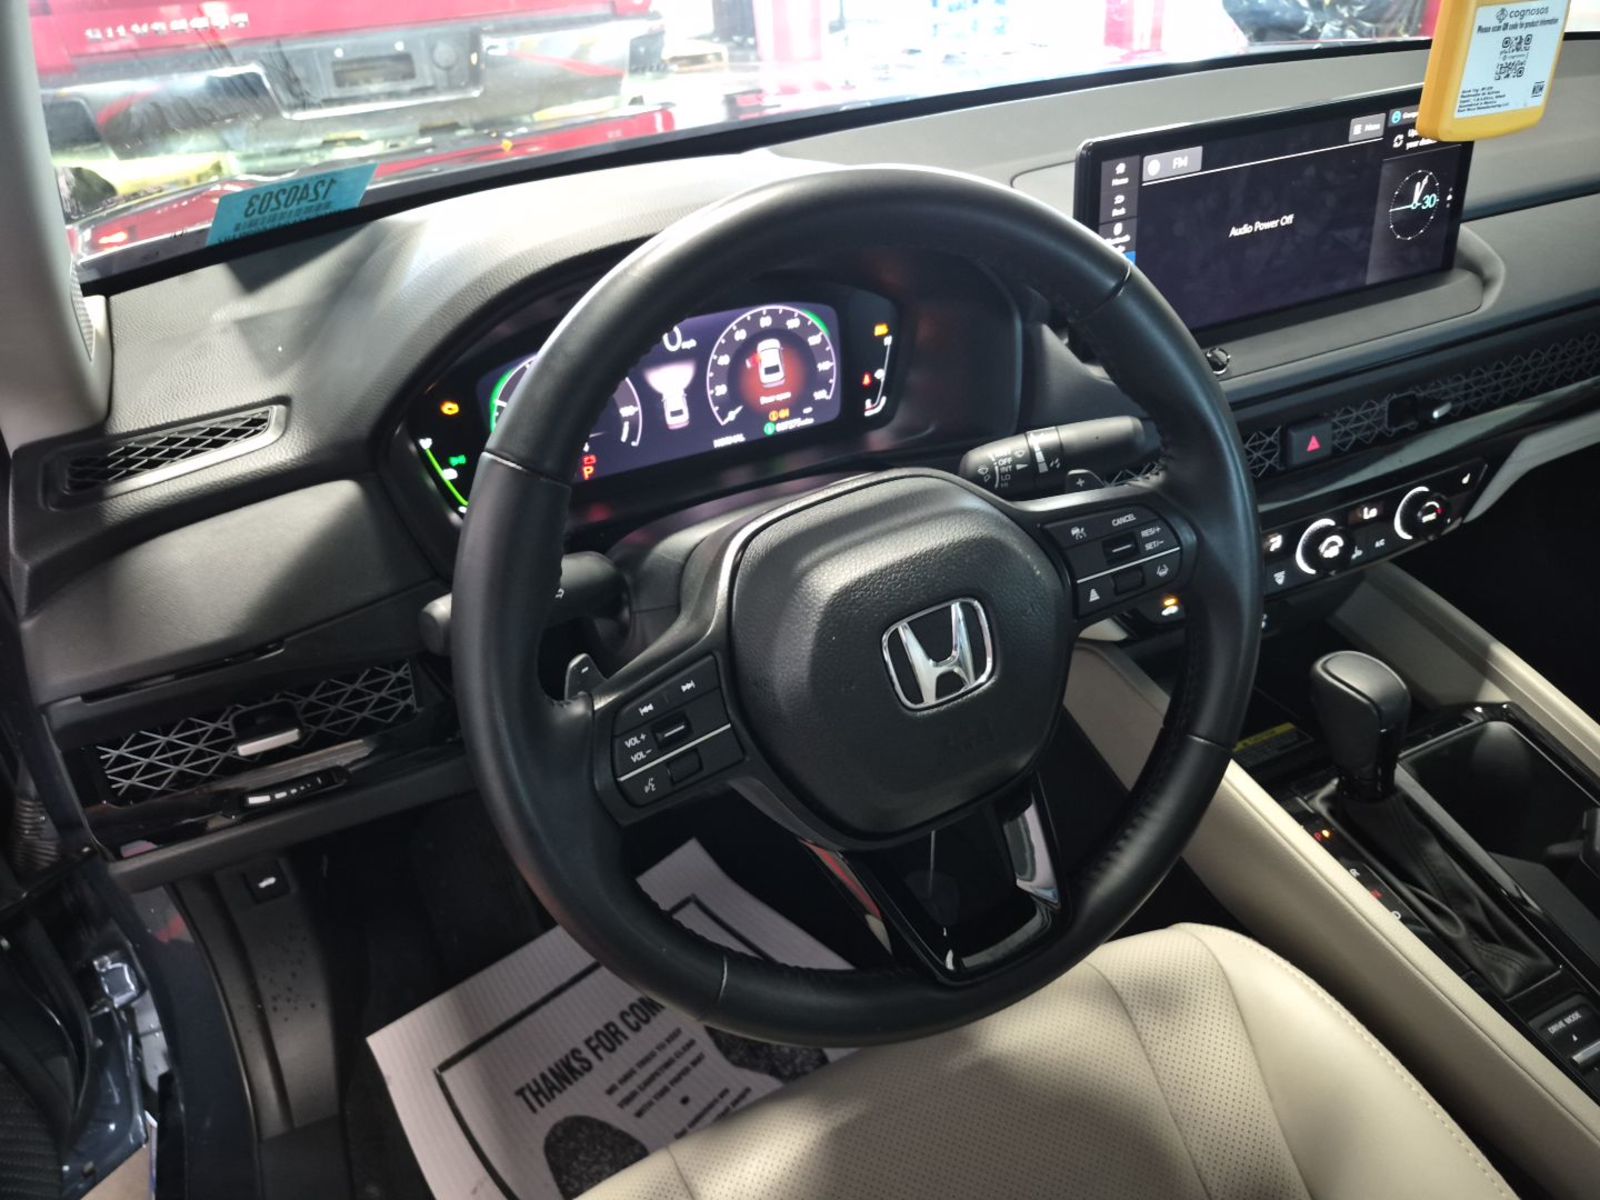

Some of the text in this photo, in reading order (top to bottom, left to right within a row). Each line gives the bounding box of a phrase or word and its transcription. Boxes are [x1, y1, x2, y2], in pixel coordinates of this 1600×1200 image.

[1172, 156, 1188, 170] FM
[1228, 213, 1295, 238] Audio Power Off
[998, 457, 1012, 466] OFF
[583, 466, 594, 480] P
[1112, 513, 1136, 526] CANCEL
[514, 1047, 593, 1114] THANKS
[584, 1021, 629, 1062] FOR
